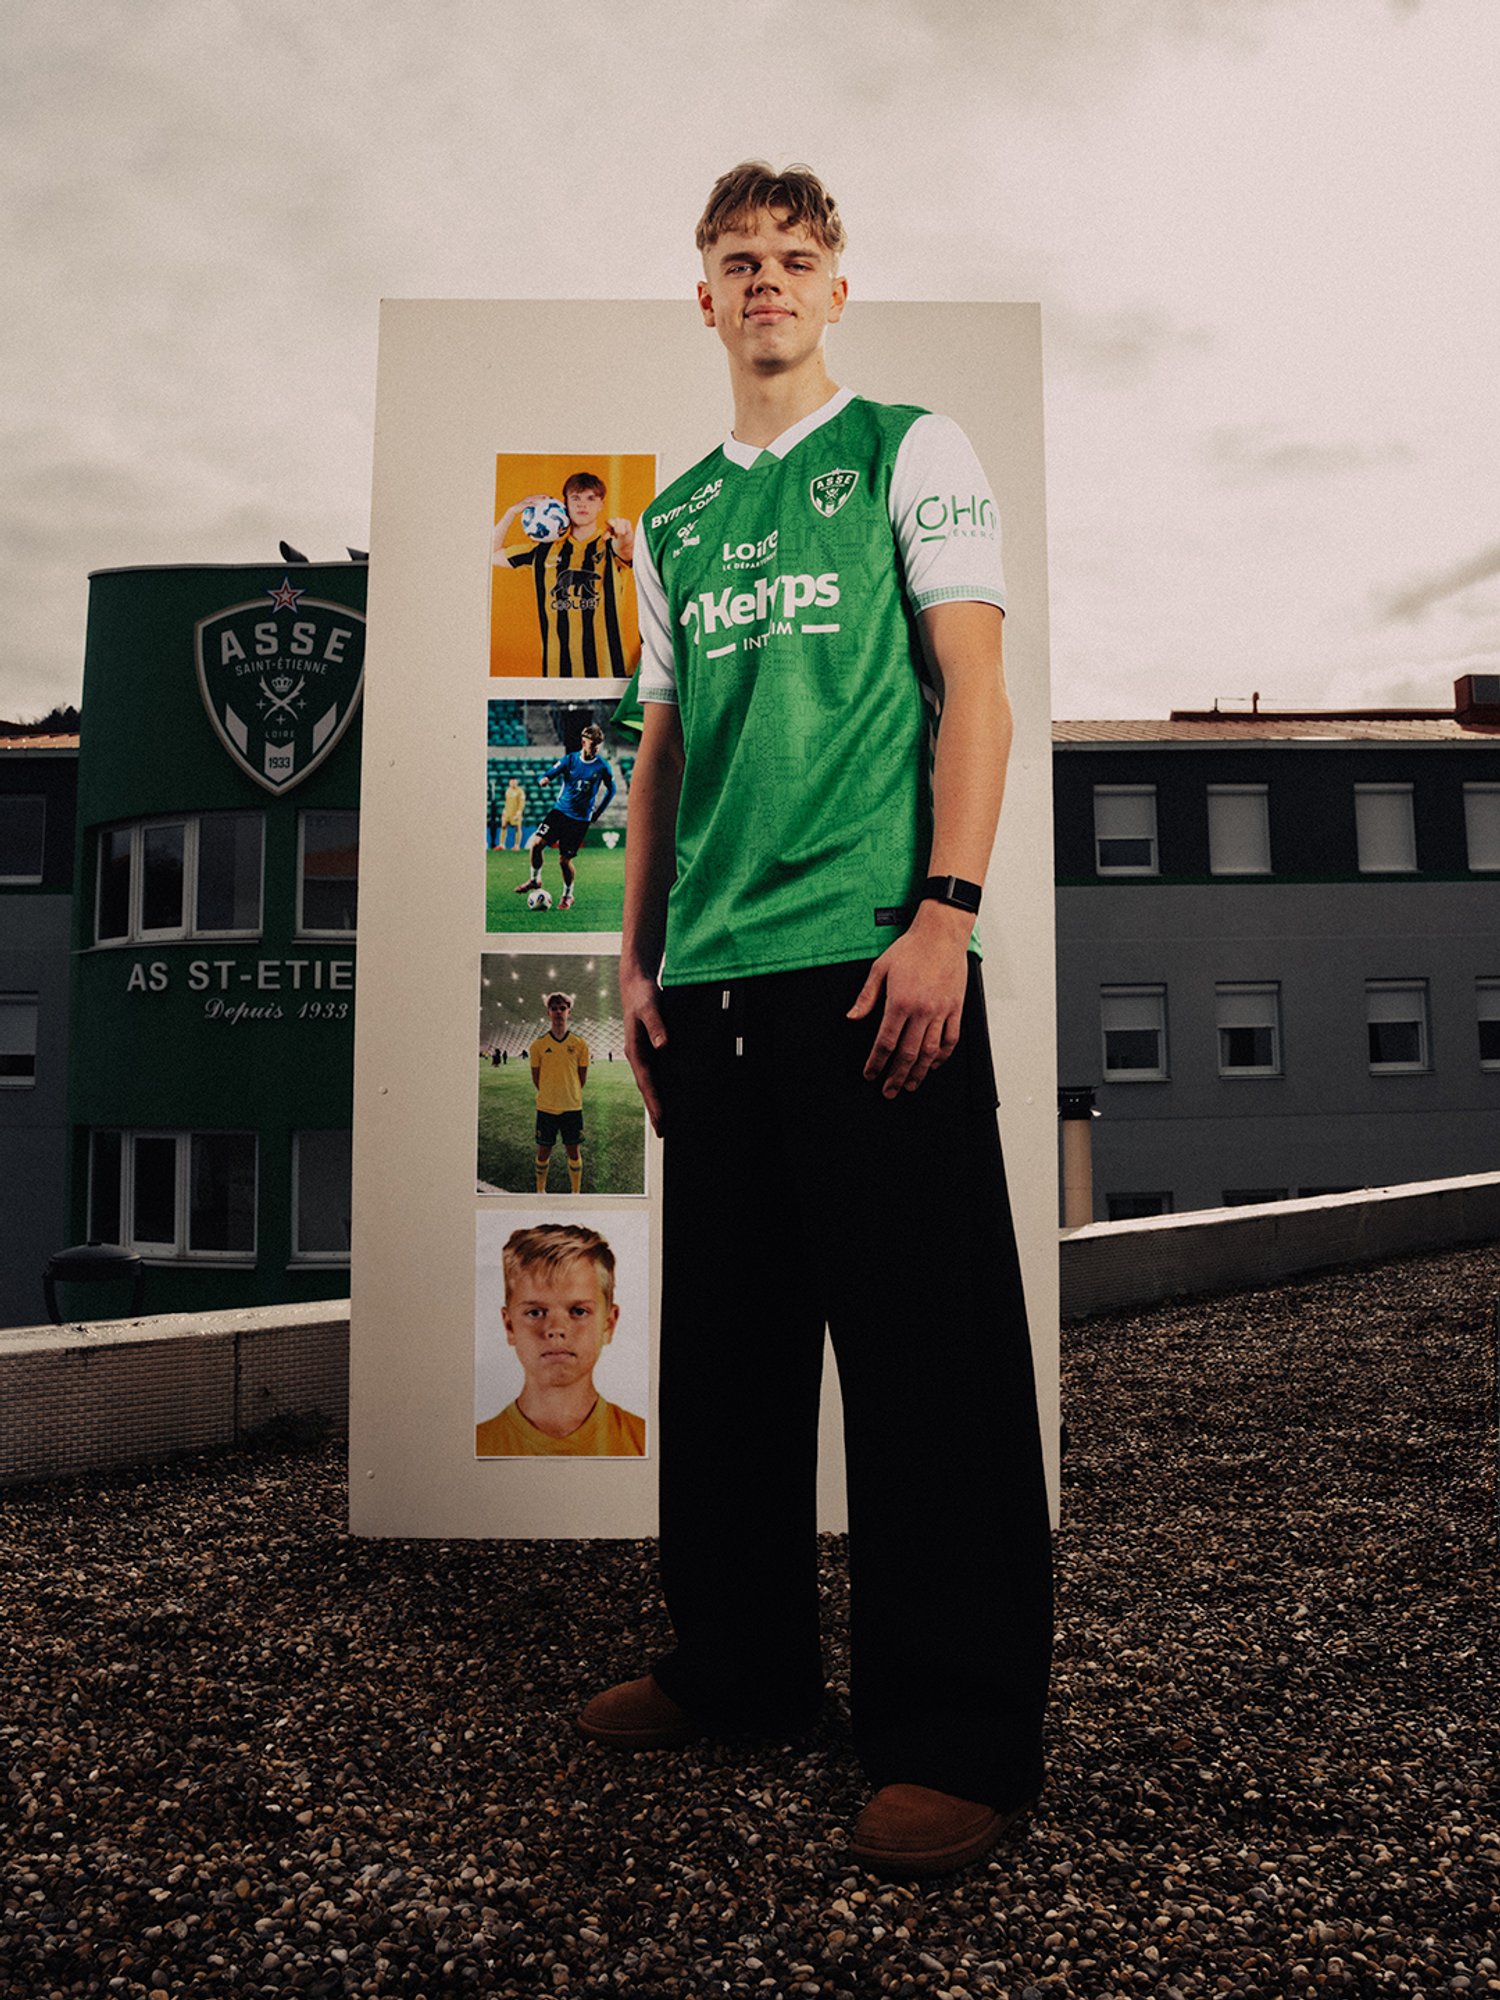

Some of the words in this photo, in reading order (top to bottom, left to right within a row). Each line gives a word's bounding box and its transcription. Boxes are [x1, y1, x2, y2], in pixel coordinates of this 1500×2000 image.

[221, 621, 353, 666] ASSE
[235, 656, 328, 677] SAINT-ÉTIENNE
[265, 730, 295, 739] LOIRE
[269, 756, 290, 769] 1933
[127, 961, 169, 992] AS
[188, 959, 354, 991] ST-ETIE
[204, 998, 284, 1026] Depuis
[297, 1001, 349, 1020] 1933
